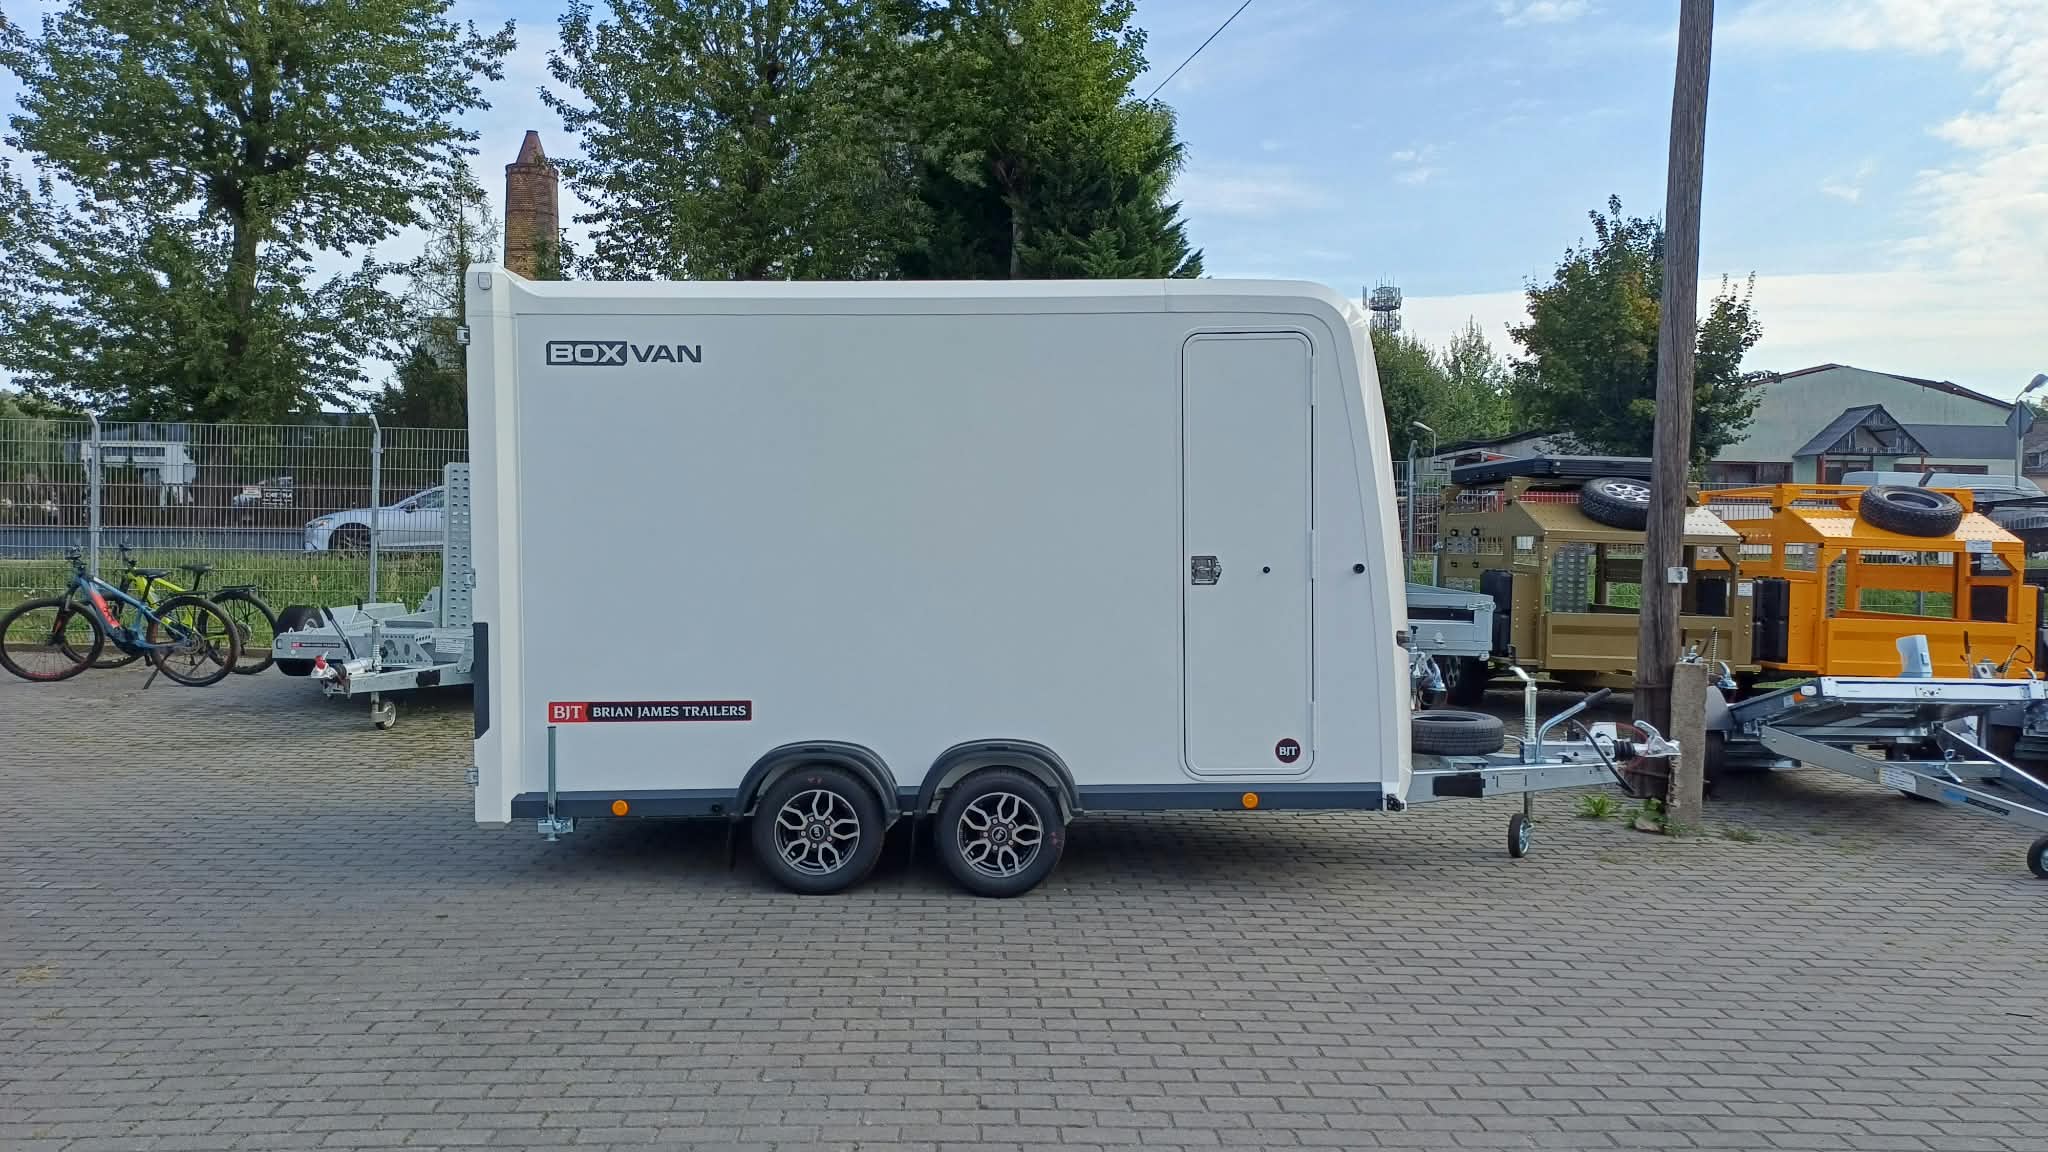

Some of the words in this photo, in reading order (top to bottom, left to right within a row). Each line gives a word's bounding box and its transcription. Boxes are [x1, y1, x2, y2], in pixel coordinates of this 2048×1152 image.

[550, 344, 625, 363] BOX
[630, 345, 702, 363] VAN
[553, 705, 583, 720] BJT
[592, 706, 634, 718] BRIAN
[637, 706, 679, 718] JAMES
[682, 705, 747, 717] TRAILERS
